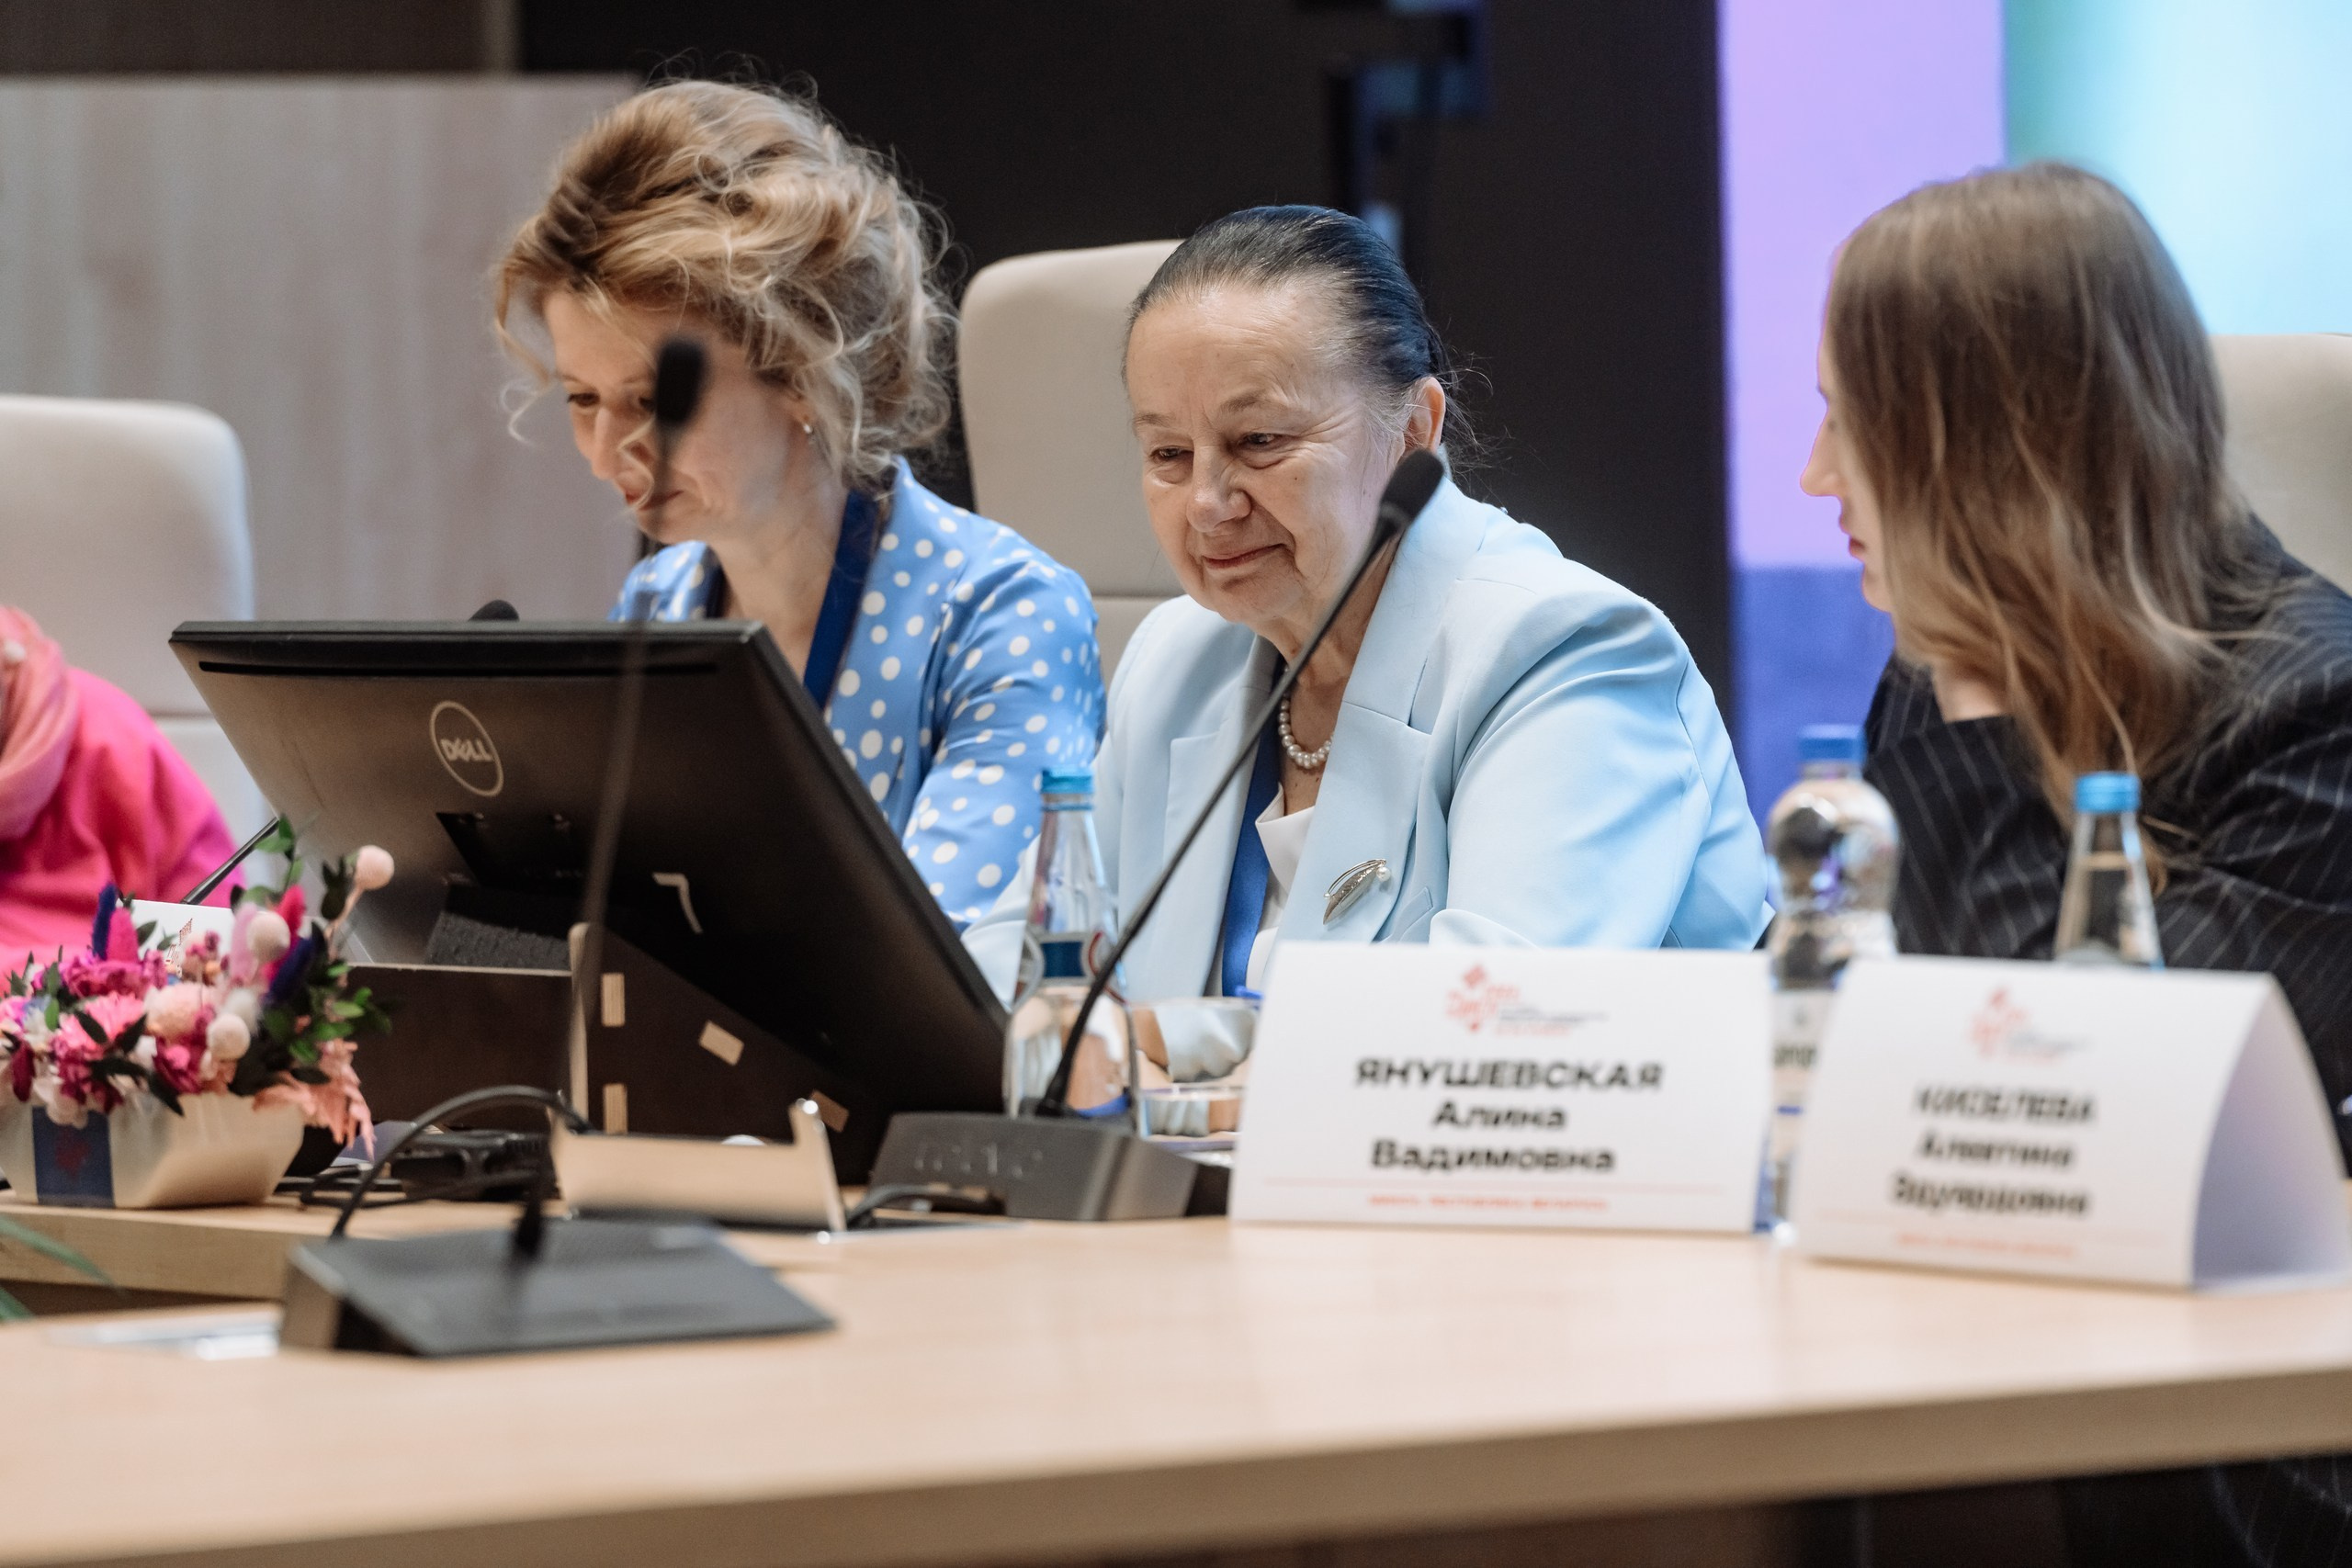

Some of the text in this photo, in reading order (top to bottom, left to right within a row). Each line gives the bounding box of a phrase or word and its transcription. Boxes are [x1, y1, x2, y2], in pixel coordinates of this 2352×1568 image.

[440, 738, 493, 761] DELL
[1354, 1058, 1664, 1090] ЯНУШЕВСКАЯ
[1432, 1100, 1567, 1129] Алина
[1371, 1139, 1615, 1171] Вадимовна
